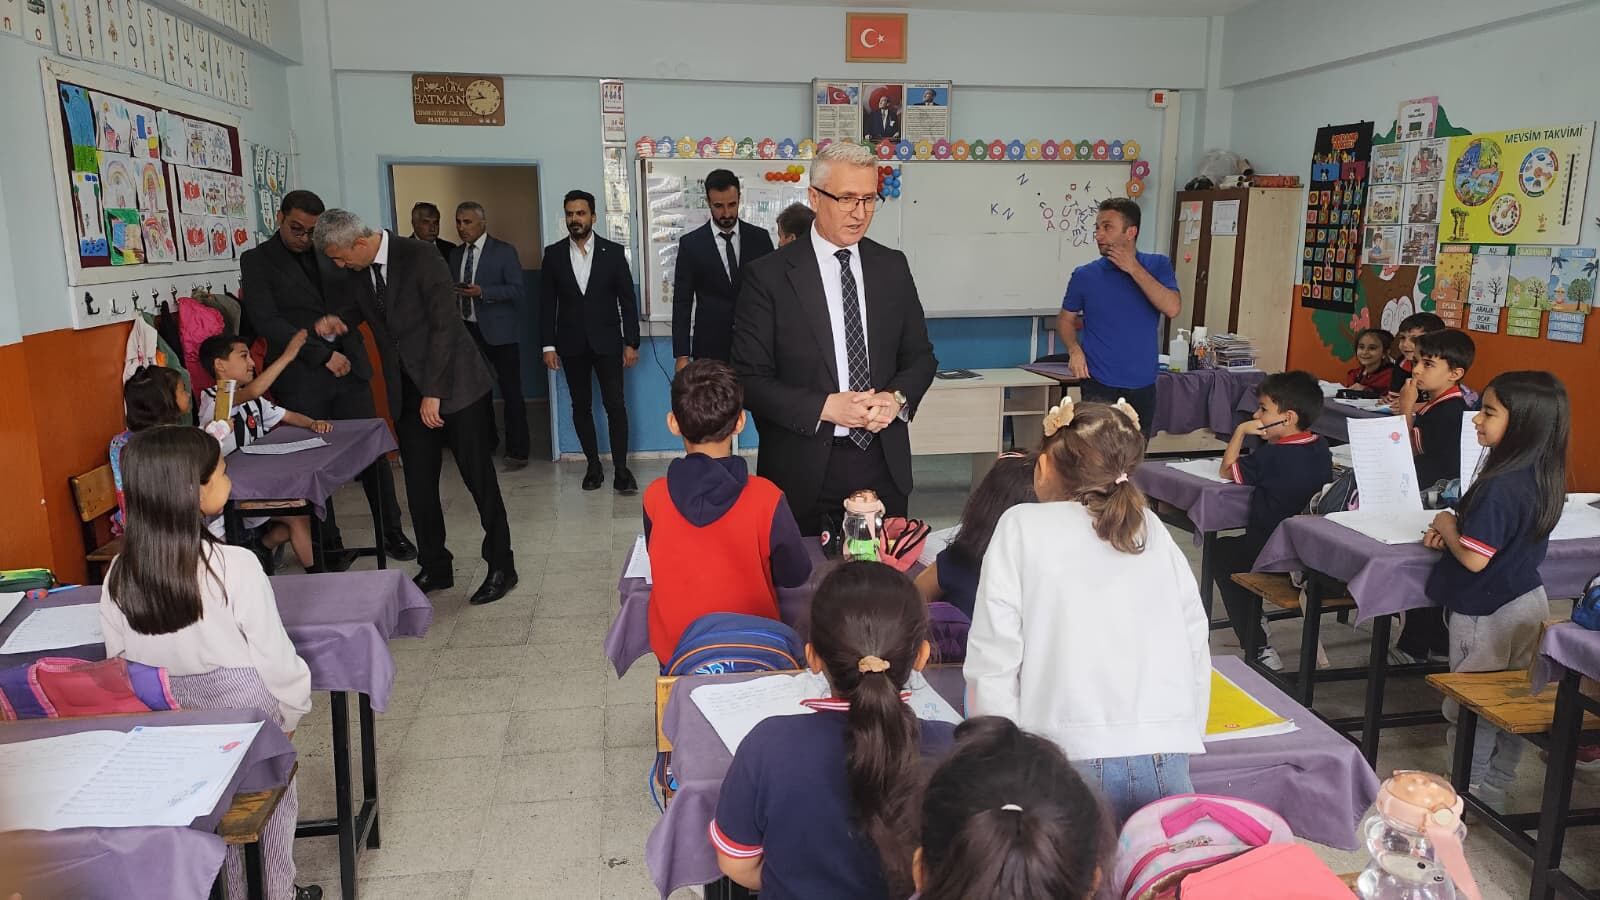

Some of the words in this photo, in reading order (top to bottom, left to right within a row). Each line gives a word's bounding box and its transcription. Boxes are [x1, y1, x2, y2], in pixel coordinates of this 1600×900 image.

[415, 94, 465, 105] BATMAN
[1504, 130, 1541, 144] MEVSİM
[1544, 125, 1583, 140] TAKVİMİ
